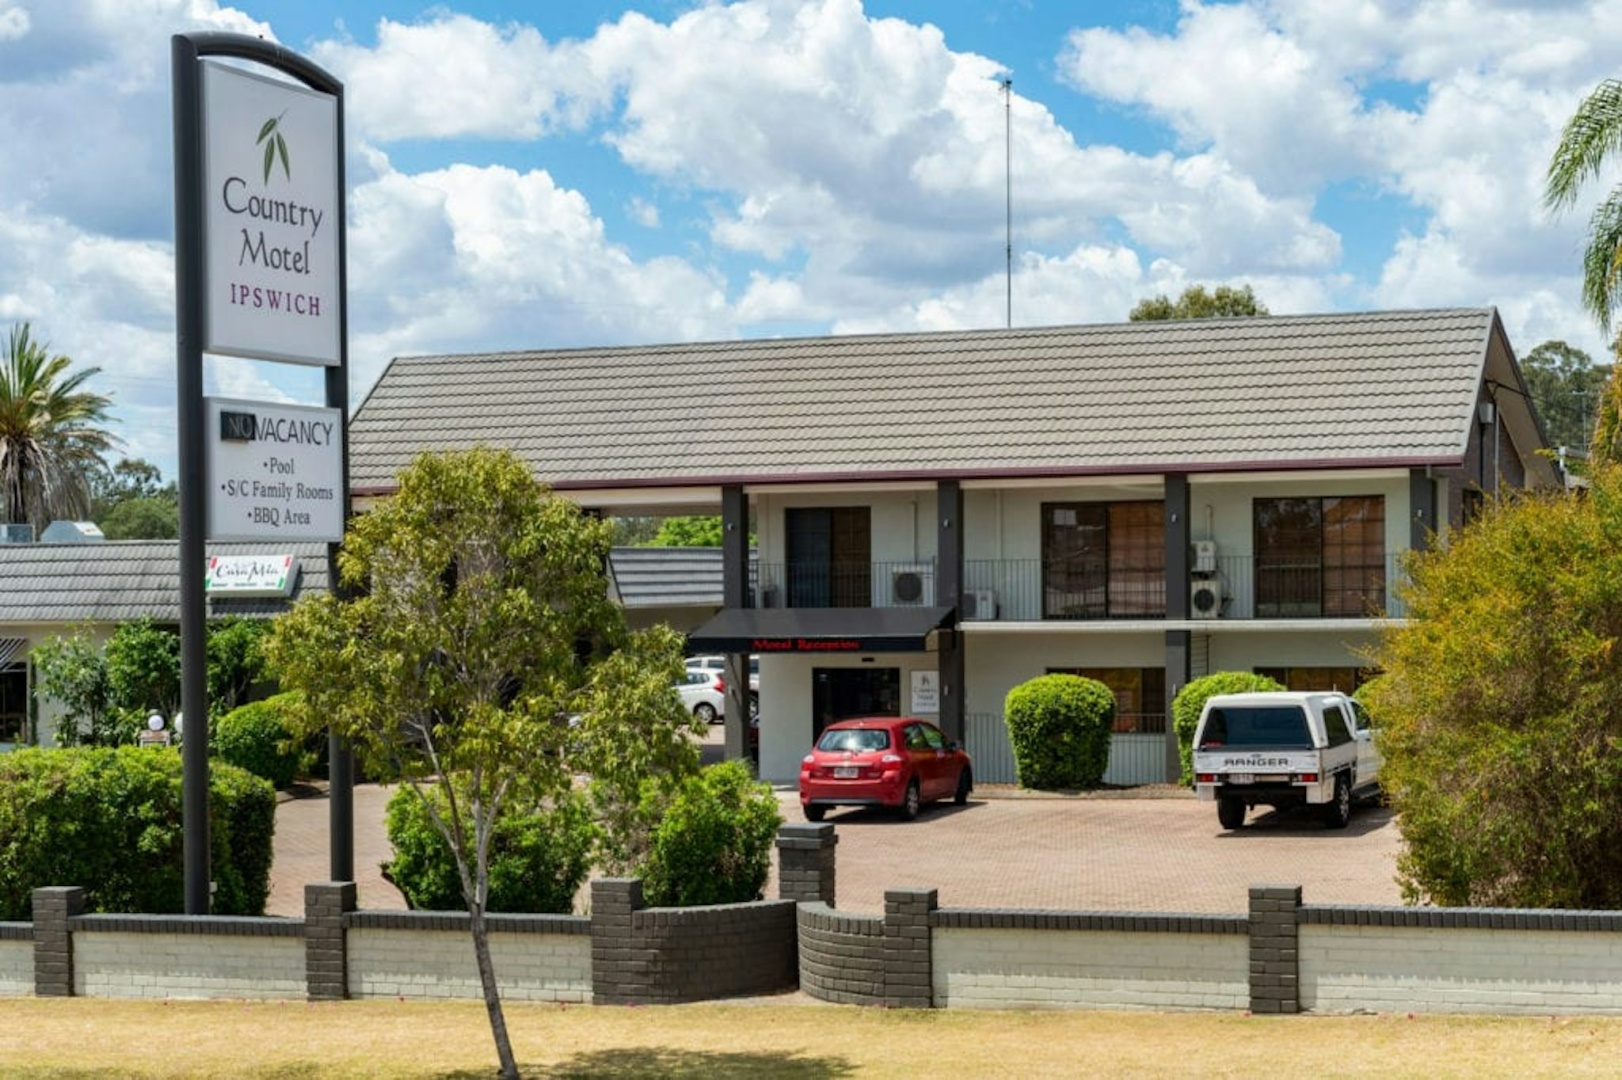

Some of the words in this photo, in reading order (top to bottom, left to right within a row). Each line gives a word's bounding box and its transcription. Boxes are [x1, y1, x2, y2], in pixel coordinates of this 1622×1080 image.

[222, 177, 323, 237] Country
[239, 228, 310, 275] Motel
[231, 283, 320, 316] IPSWICH
[255, 417, 333, 446] VACANCY
[270, 457, 295, 475] Pool
[227, 480, 249, 498] S/C
[252, 481, 293, 502] Family
[296, 484, 333, 501] Rooms
[254, 507, 280, 527] BBQ
[283, 508, 310, 525] Area
[1224, 758, 1289, 767] RANGER
